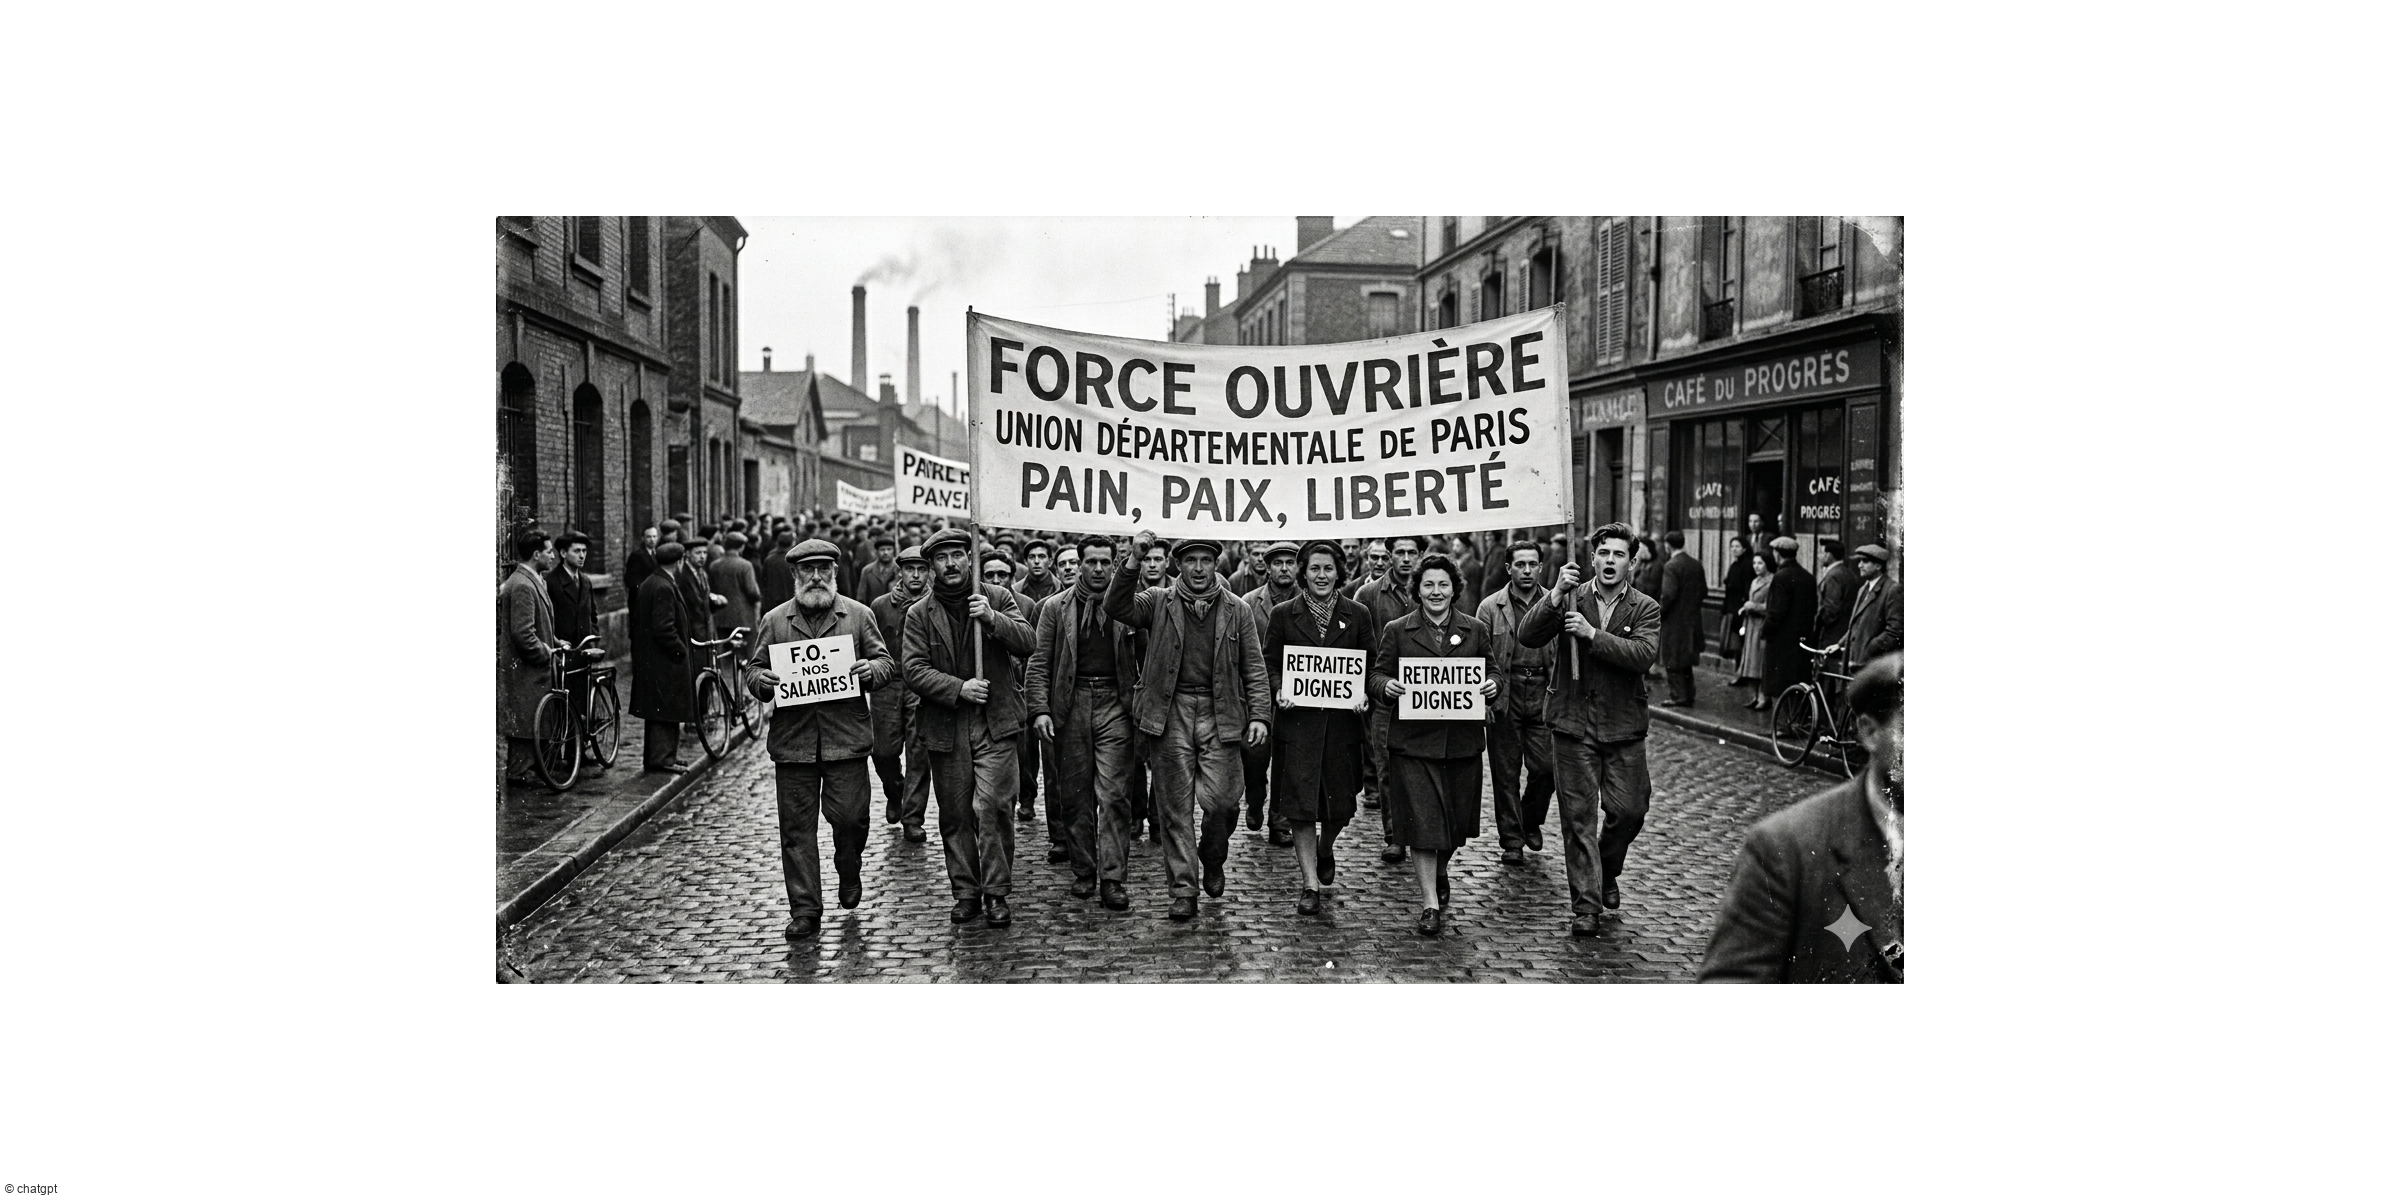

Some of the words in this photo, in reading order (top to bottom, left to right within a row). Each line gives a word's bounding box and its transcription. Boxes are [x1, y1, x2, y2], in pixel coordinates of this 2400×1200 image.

[991, 337, 1196, 415] FORCE
[1226, 331, 1545, 418] OUVRIÈRE
[1664, 373, 1706, 408] CAFÉ
[1715, 377, 1735, 401] DU
[997, 409, 1082, 452] UNION
[1098, 418, 1364, 465] DÉPARTEMENTALE
[1381, 427, 1416, 459] DE
[1431, 408, 1529, 454] PARIS
[1022, 462, 1141, 523] PAIN,
[1163, 475, 1286, 528] PAIX,
[1307, 451, 1509, 521] LIBERTÉ
[1809, 475, 1841, 495] CAFÉ
[802, 664, 829, 676] NOS
[1287, 654, 1363, 675] RETRAITES
[1404, 666, 1482, 684] RETRAITES
[1294, 678, 1353, 699] DIGNES
[1412, 690, 1472, 709] DIGNES
